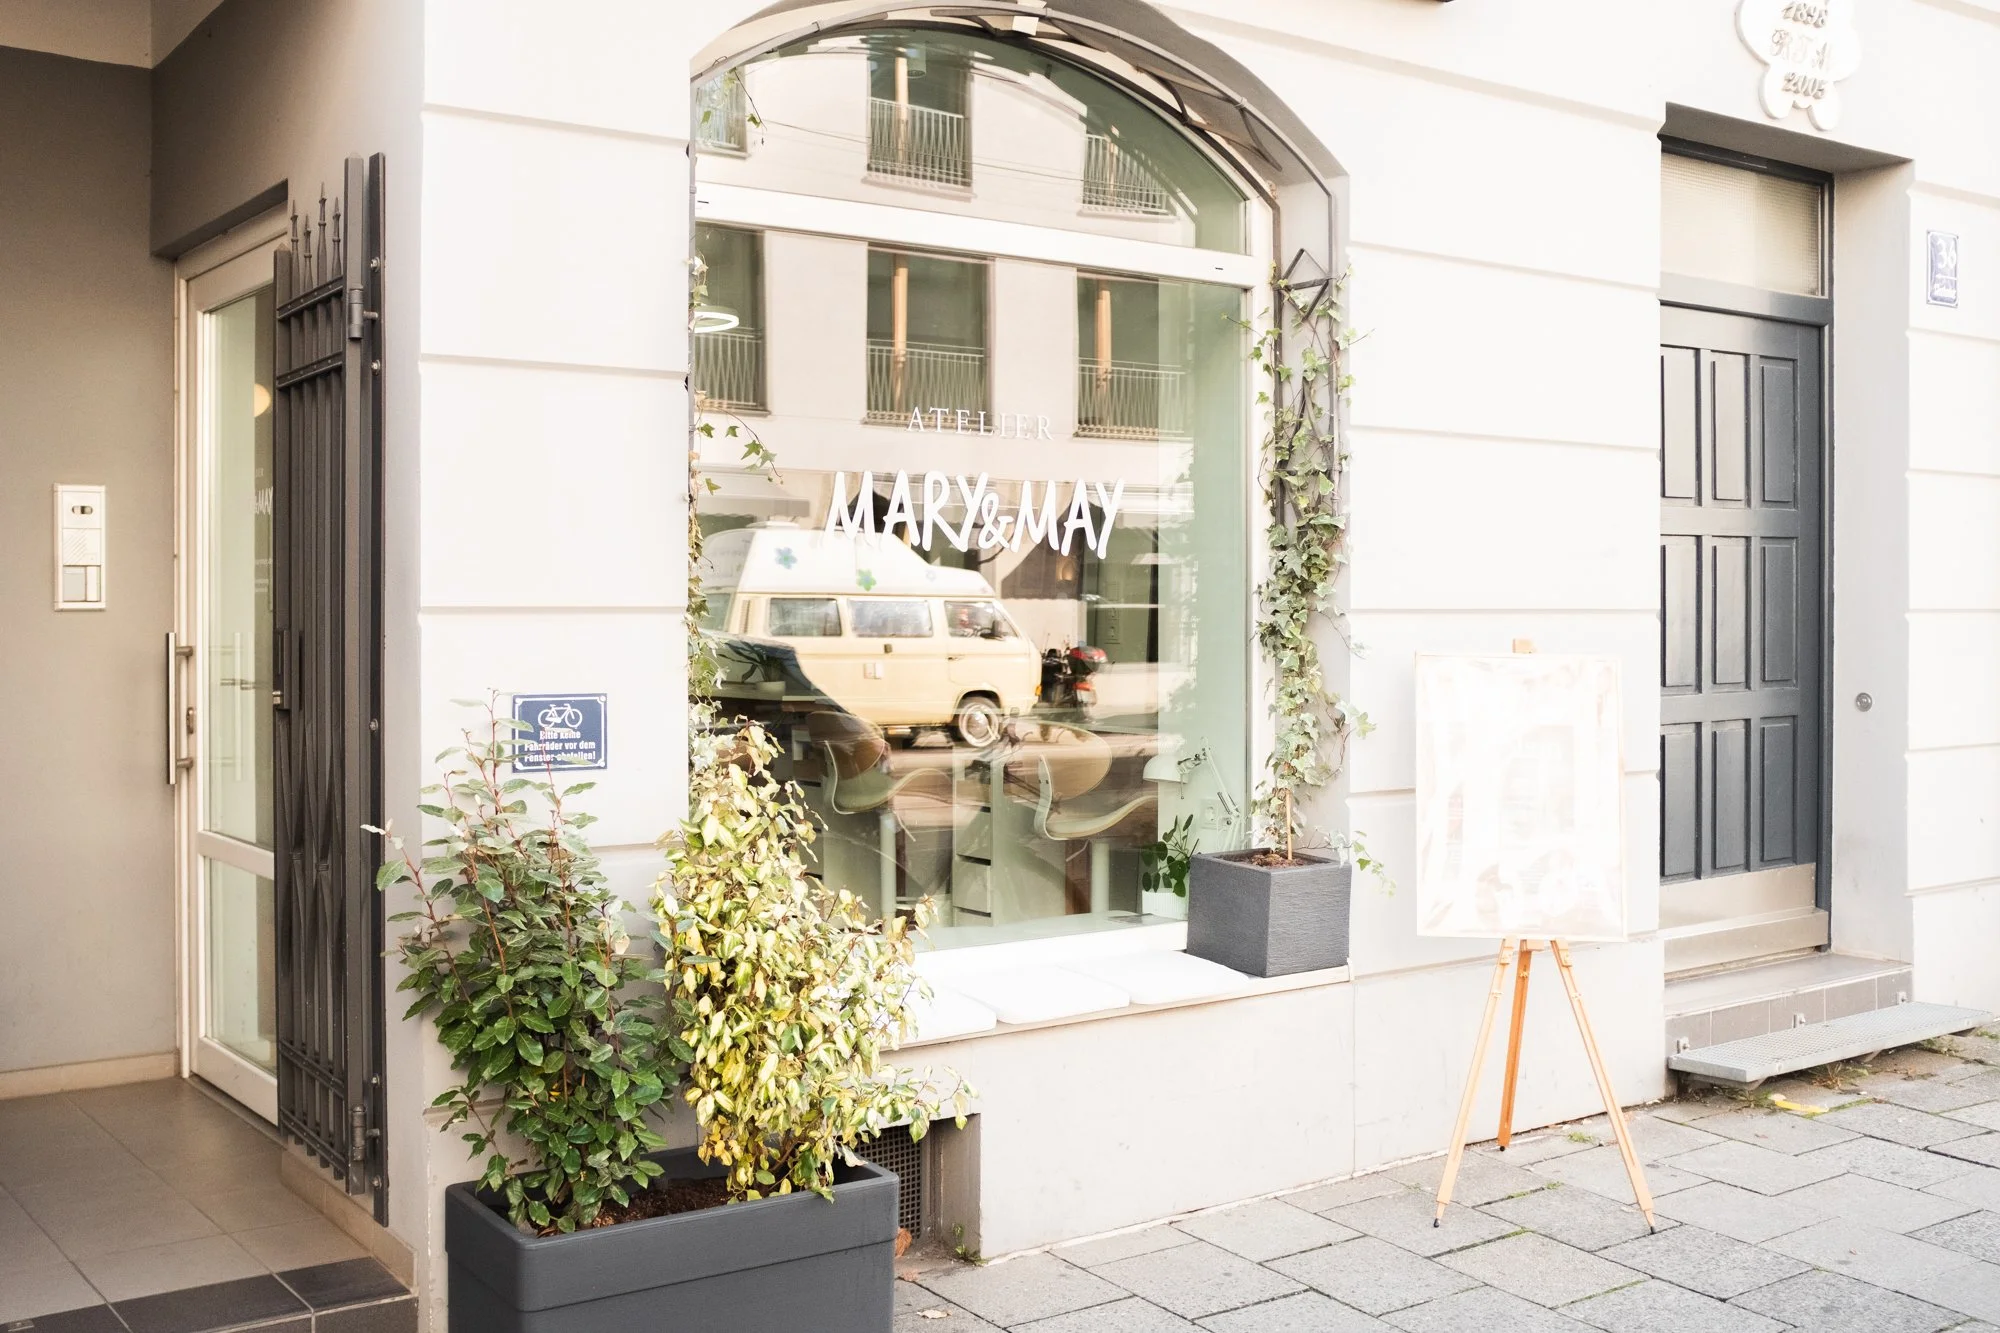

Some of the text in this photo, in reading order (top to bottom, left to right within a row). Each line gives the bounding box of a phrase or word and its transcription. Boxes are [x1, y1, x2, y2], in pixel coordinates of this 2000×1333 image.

[1782, 1, 1828, 28] 1898
[1781, 72, 1828, 100] 2005
[1936, 238, 1957, 269] 36
[907, 406, 1053, 440] ATELIER
[565, 742, 577, 750] vor
[579, 740, 596, 749] dem
